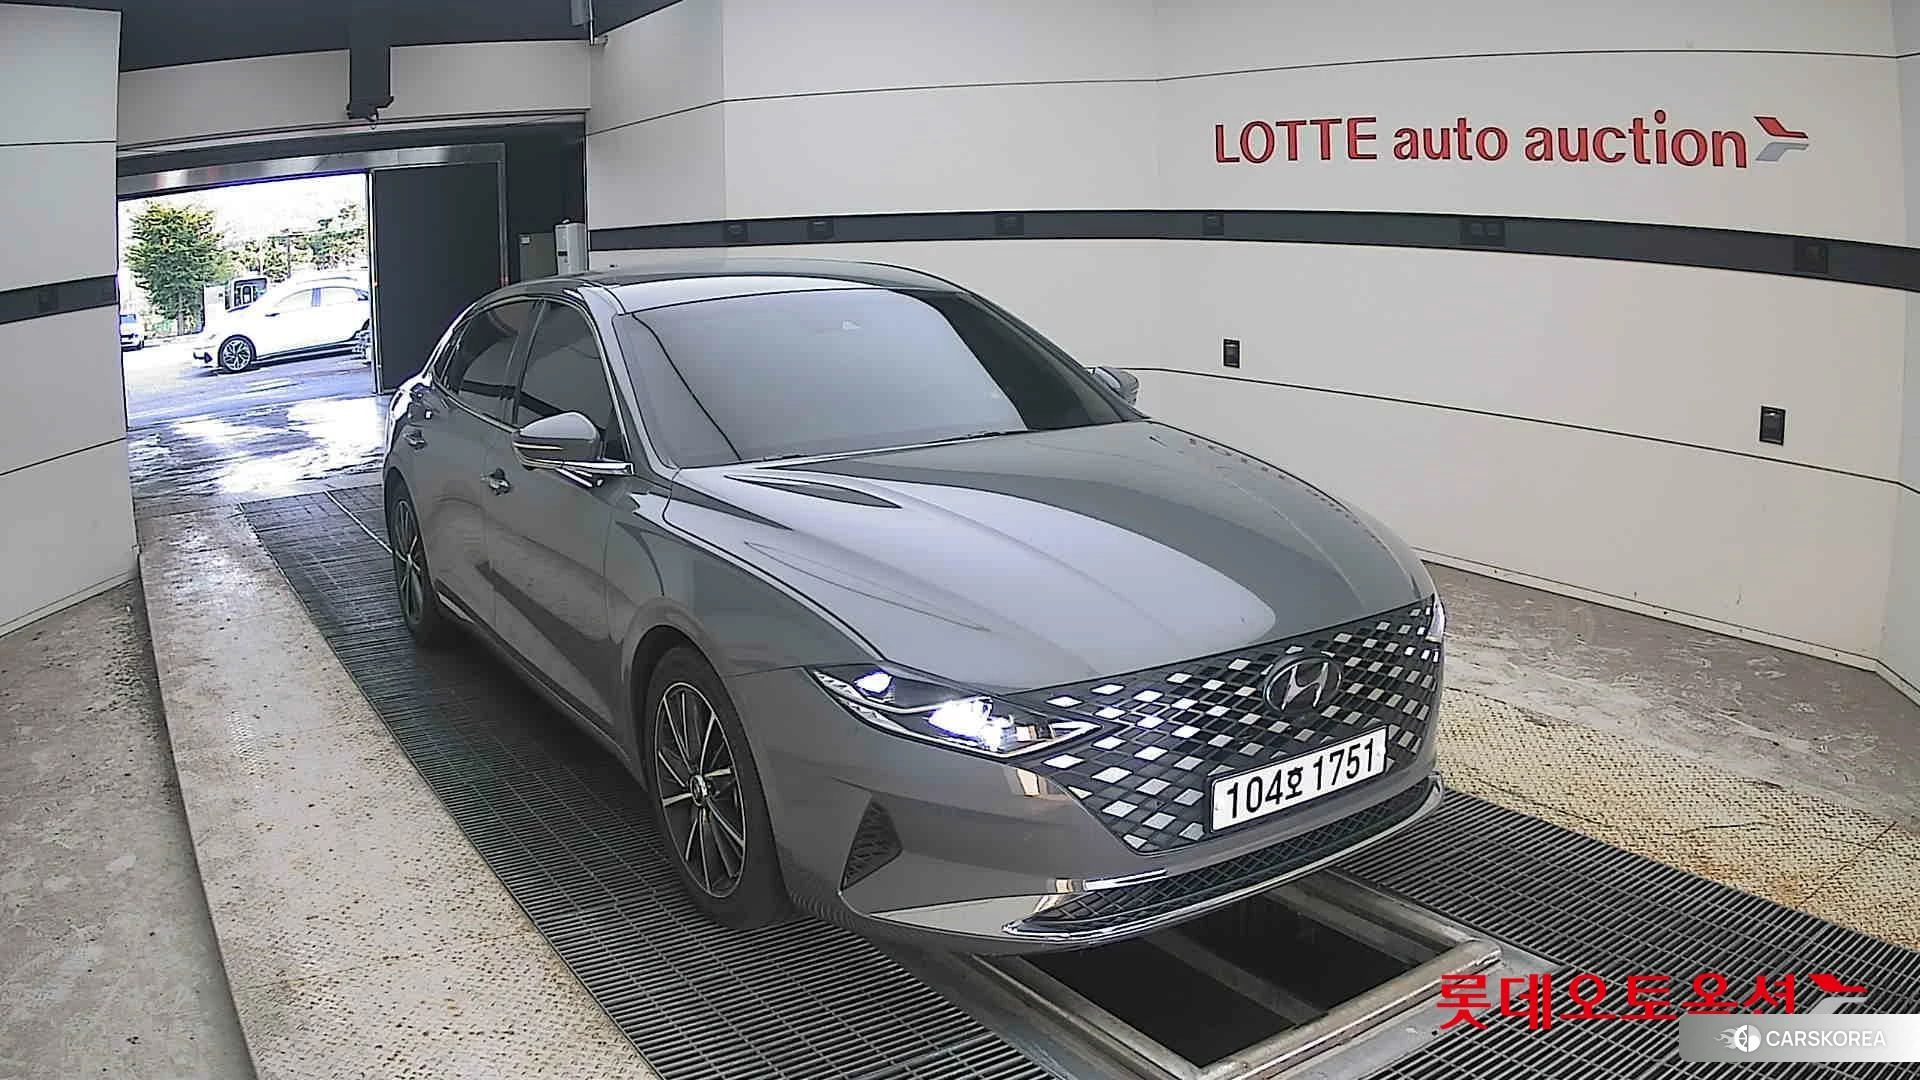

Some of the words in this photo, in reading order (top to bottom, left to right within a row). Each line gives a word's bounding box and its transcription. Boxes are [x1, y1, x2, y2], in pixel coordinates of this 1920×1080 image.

[1214, 116, 1378, 164] LOTTE
[1392, 117, 1510, 162] auto
[1524, 109, 1749, 169] auction
[1226, 766, 1304, 819] 104호
[1313, 737, 1374, 791] 1751
